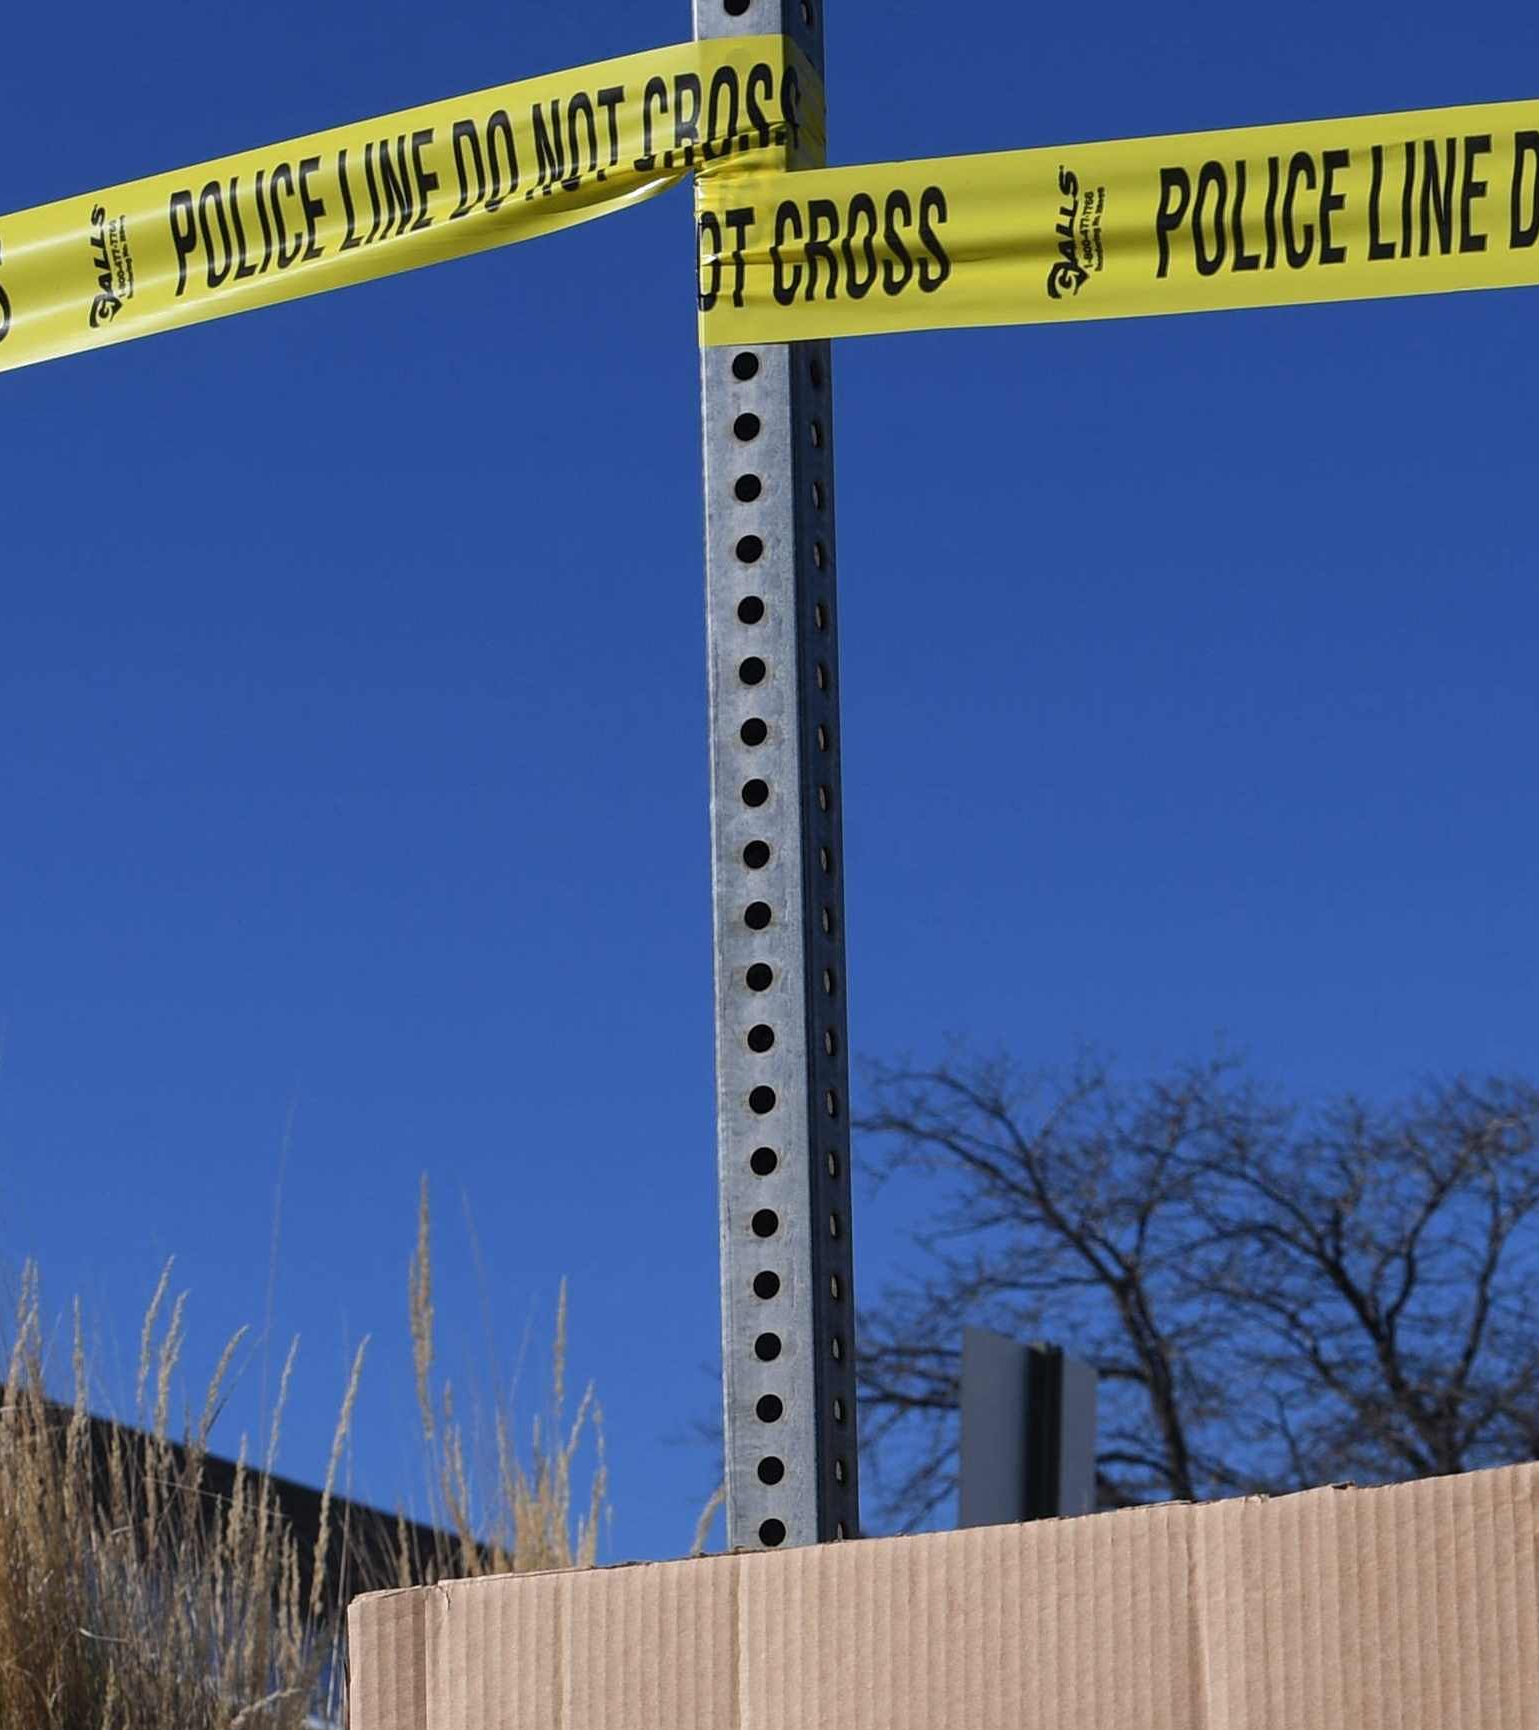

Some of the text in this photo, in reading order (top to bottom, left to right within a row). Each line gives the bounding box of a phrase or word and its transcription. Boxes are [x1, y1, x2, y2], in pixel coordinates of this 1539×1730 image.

[170, 155, 326, 297] POLICE
[339, 129, 439, 252] LINE
[450, 110, 520, 219] DO
[525, 86, 624, 200] NOT
[633, 63, 802, 171] CROSS
[770, 186, 951, 305] CROSS
[1047, 165, 1089, 299] GALLS
[1156, 148, 1349, 279] POLICE
[1368, 136, 1492, 262] LINE
[89, 204, 122, 328] GALLS
